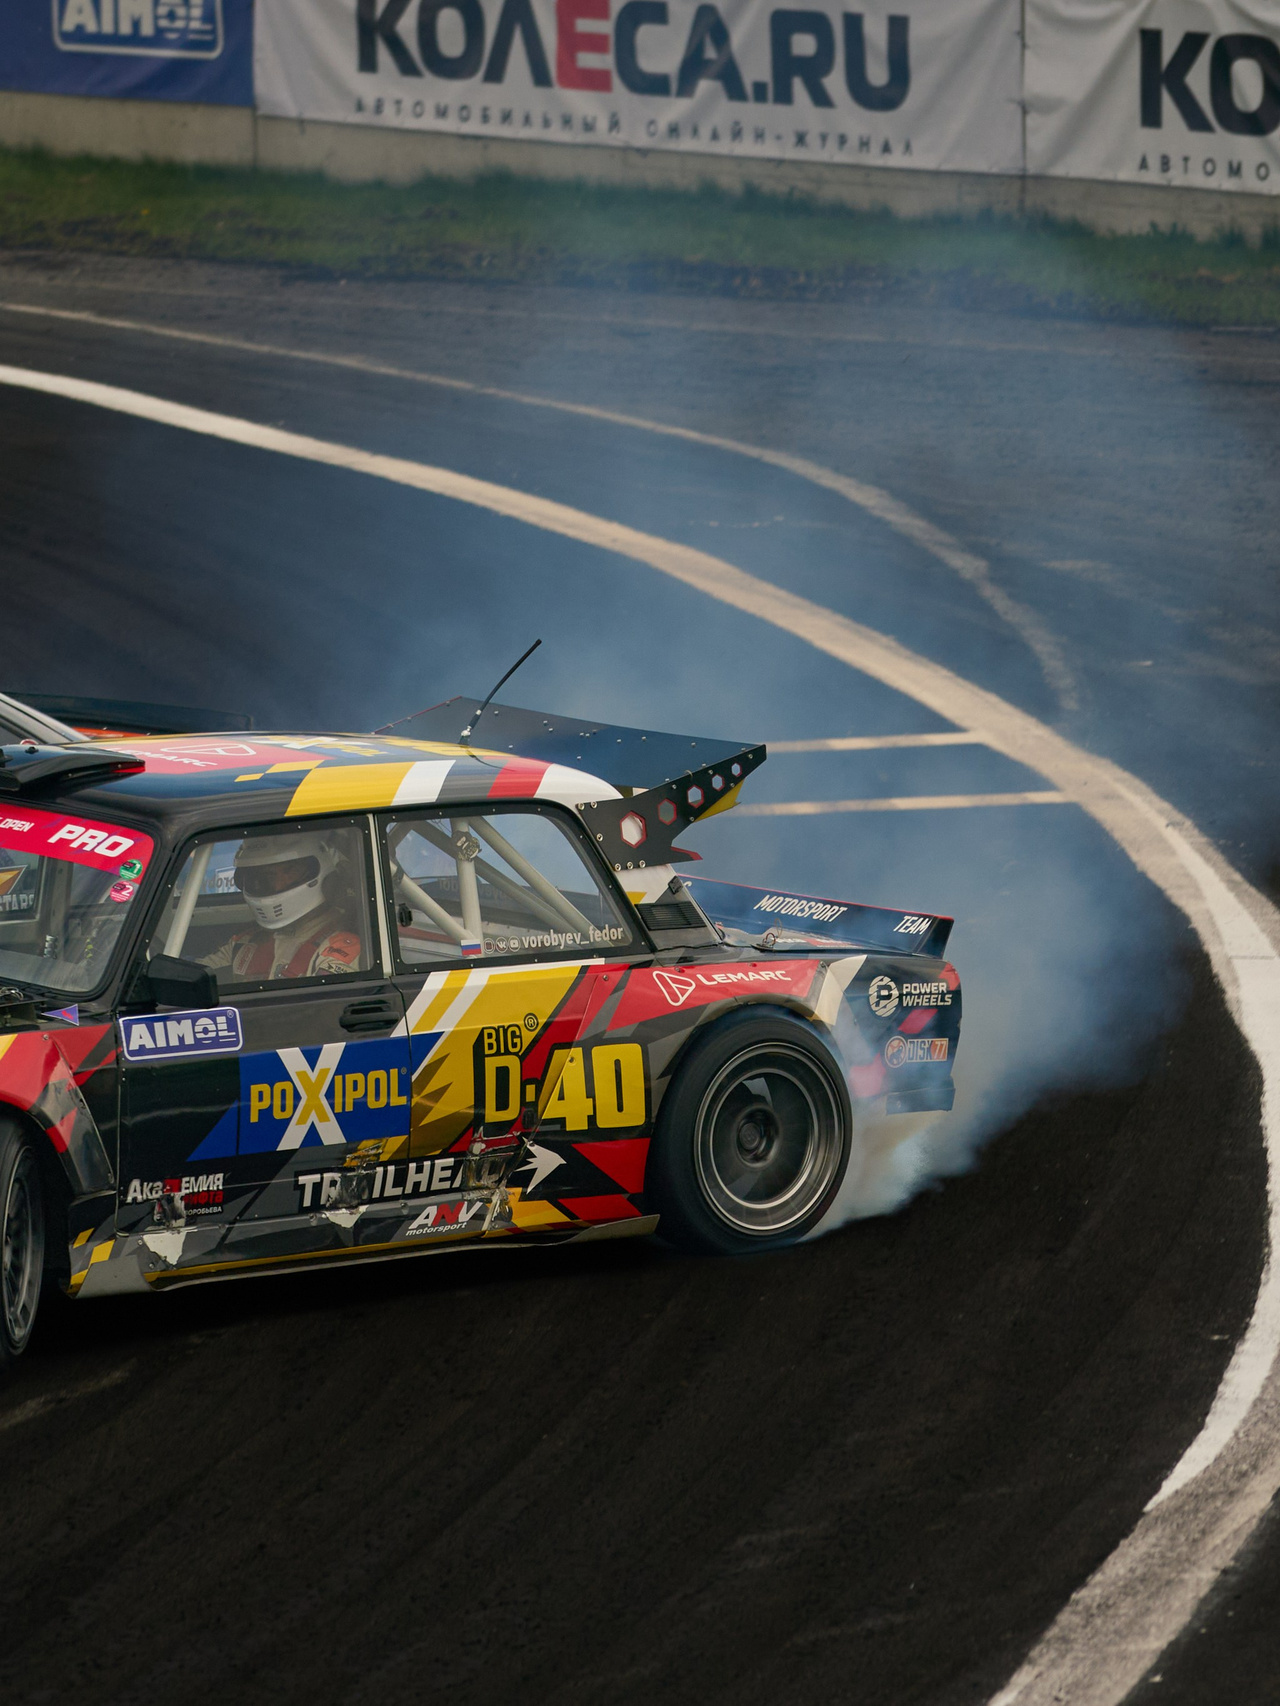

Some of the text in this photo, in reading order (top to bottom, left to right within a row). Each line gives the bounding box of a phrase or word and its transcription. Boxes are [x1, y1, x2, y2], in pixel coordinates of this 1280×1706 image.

[47, 824, 135, 858] PRO
[753, 894, 848, 923] MOTORSPORT
[521, 924, 624, 950] vorobyev_fedor
[892, 914, 933, 936] TEAM
[695, 970, 792, 986] LEMARC
[902, 982, 948, 995] POWER
[902, 994, 953, 1007] WHEELS
[128, 1015, 237, 1051] AIMOL
[483, 1025, 521, 1055] BIG
[908, 1040, 947, 1061] DISK 77
[249, 1041, 408, 1152] POXIPOL
[484, 1042, 646, 1132] D-40
[408, 1201, 484, 1230] ANV
[405, 1222, 467, 1237] motorsport
